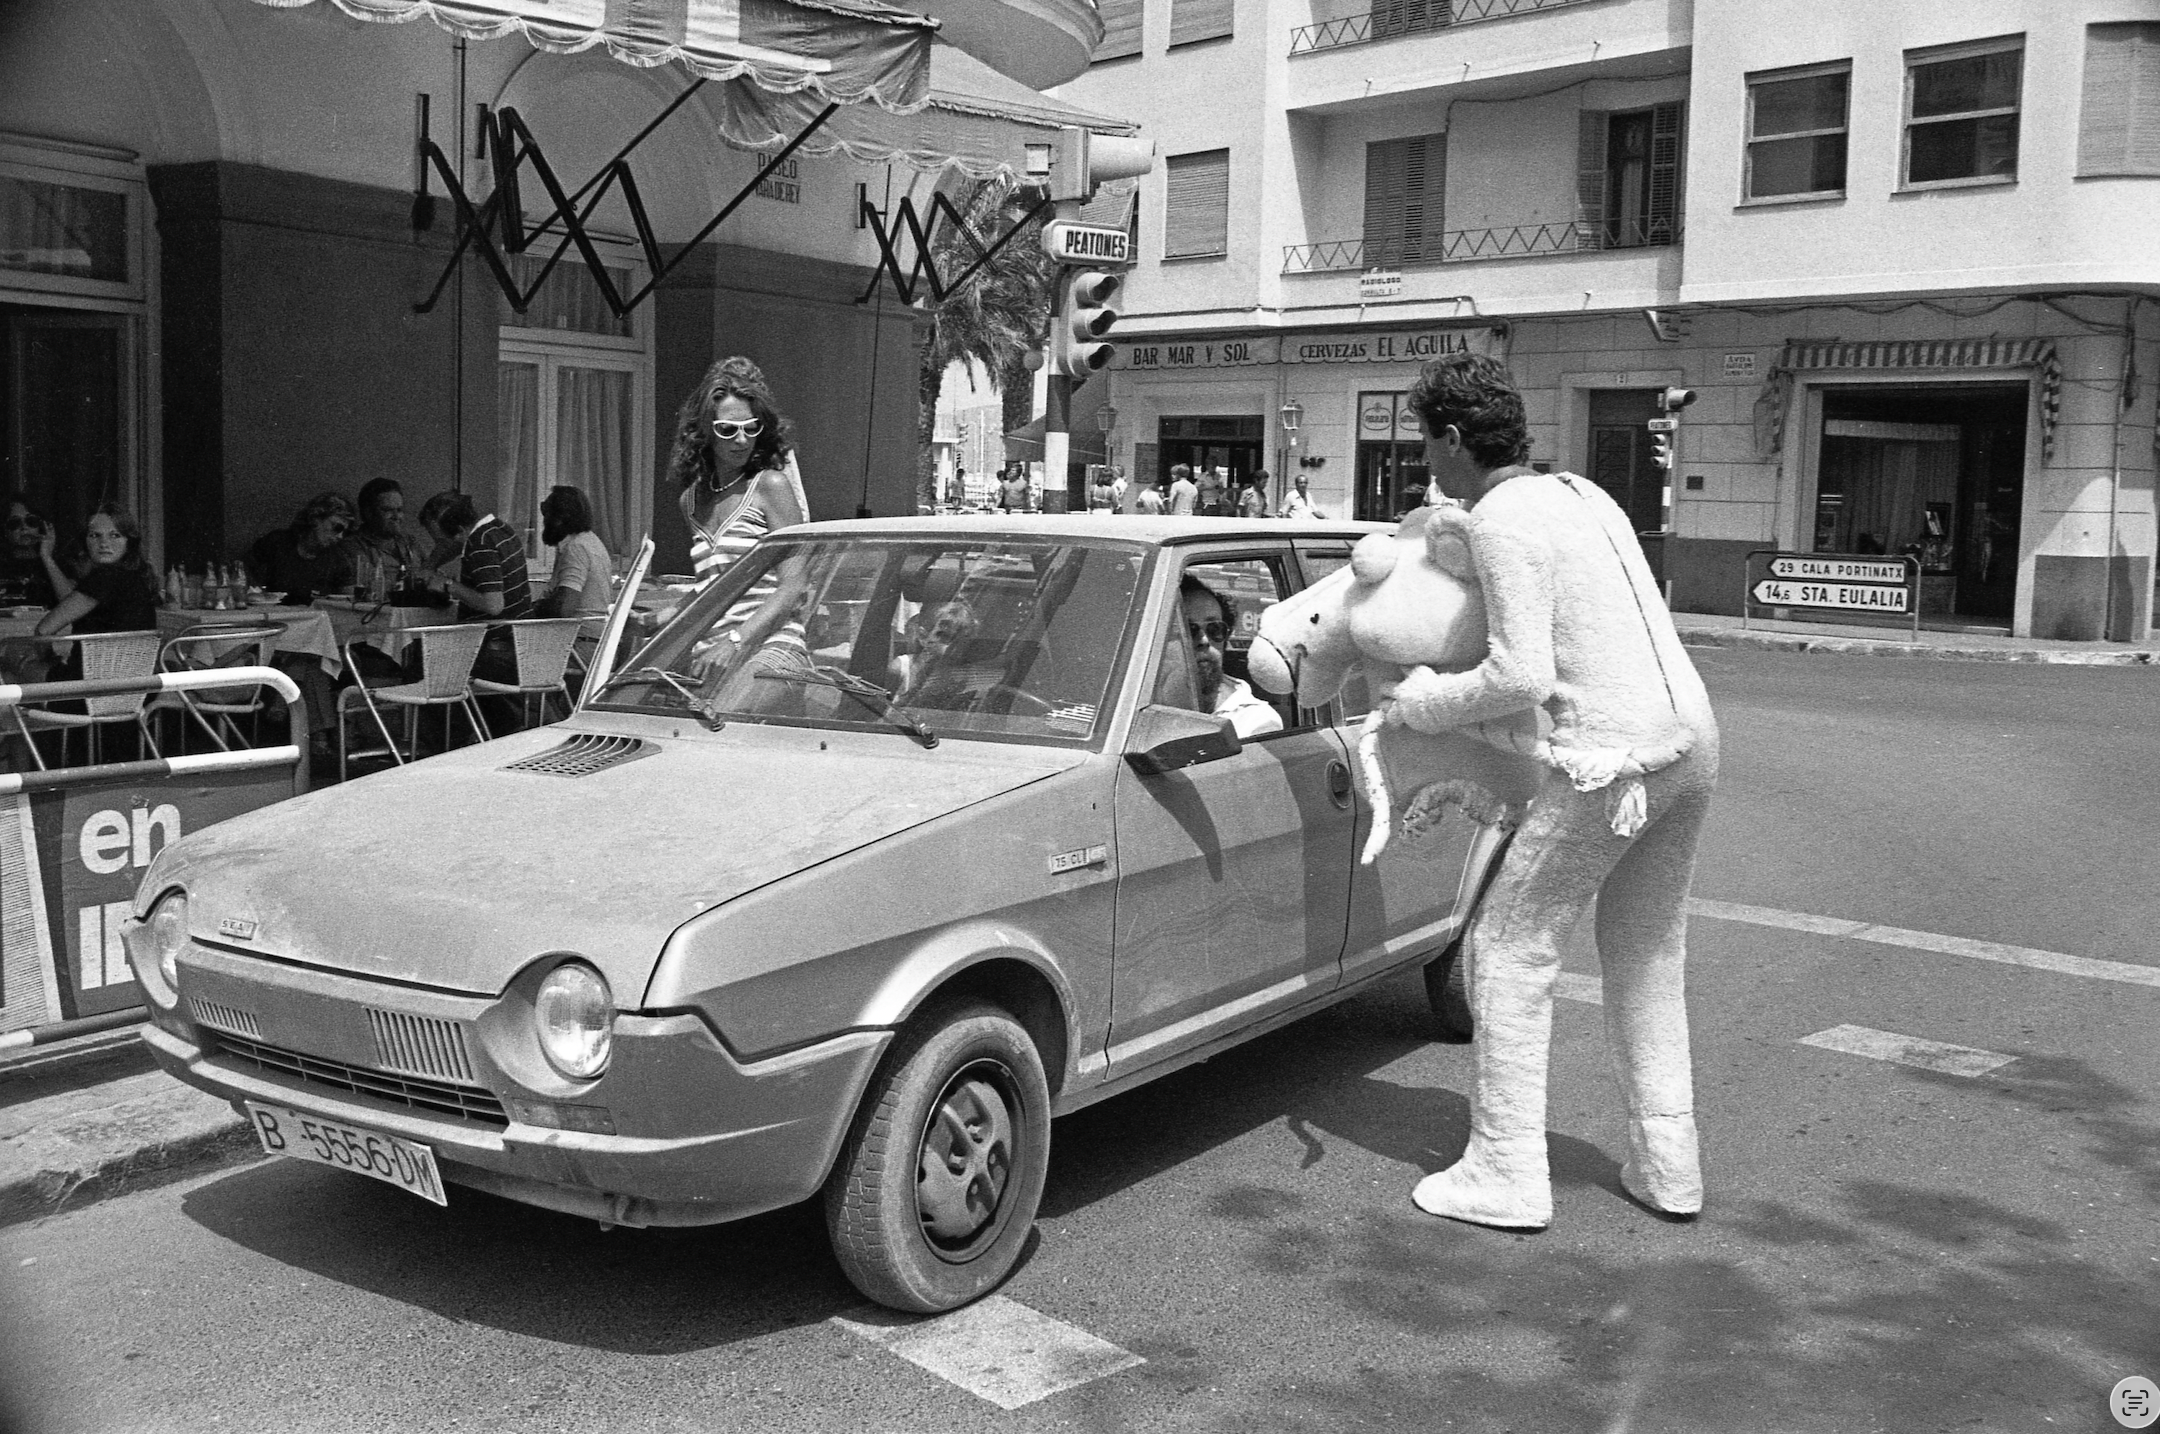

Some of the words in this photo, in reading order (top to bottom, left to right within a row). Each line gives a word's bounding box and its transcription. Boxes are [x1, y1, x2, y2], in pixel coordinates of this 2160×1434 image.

[1065, 229, 1126, 259] PEATONES
[1133, 347, 1158, 366] BAR
[1167, 345, 1195, 364] MAR
[1206, 345, 1213, 363] Y
[1223, 343, 1250, 362] SOL
[1300, 343, 1367, 358] CERVEZAS
[1377, 336, 1396, 357] EL
[1404, 333, 1469, 357] AGUILA
[1779, 562, 1794, 573] 29
[1801, 563, 1831, 575] CALA
[1838, 565, 1902, 579] PORTINATX
[1801, 586, 1833, 603] STA.
[1839, 590, 1904, 607] EULALIA
[79, 803, 181, 874] en
[1055, 856, 1066, 868] 75
[255, 1110, 286, 1150] B
